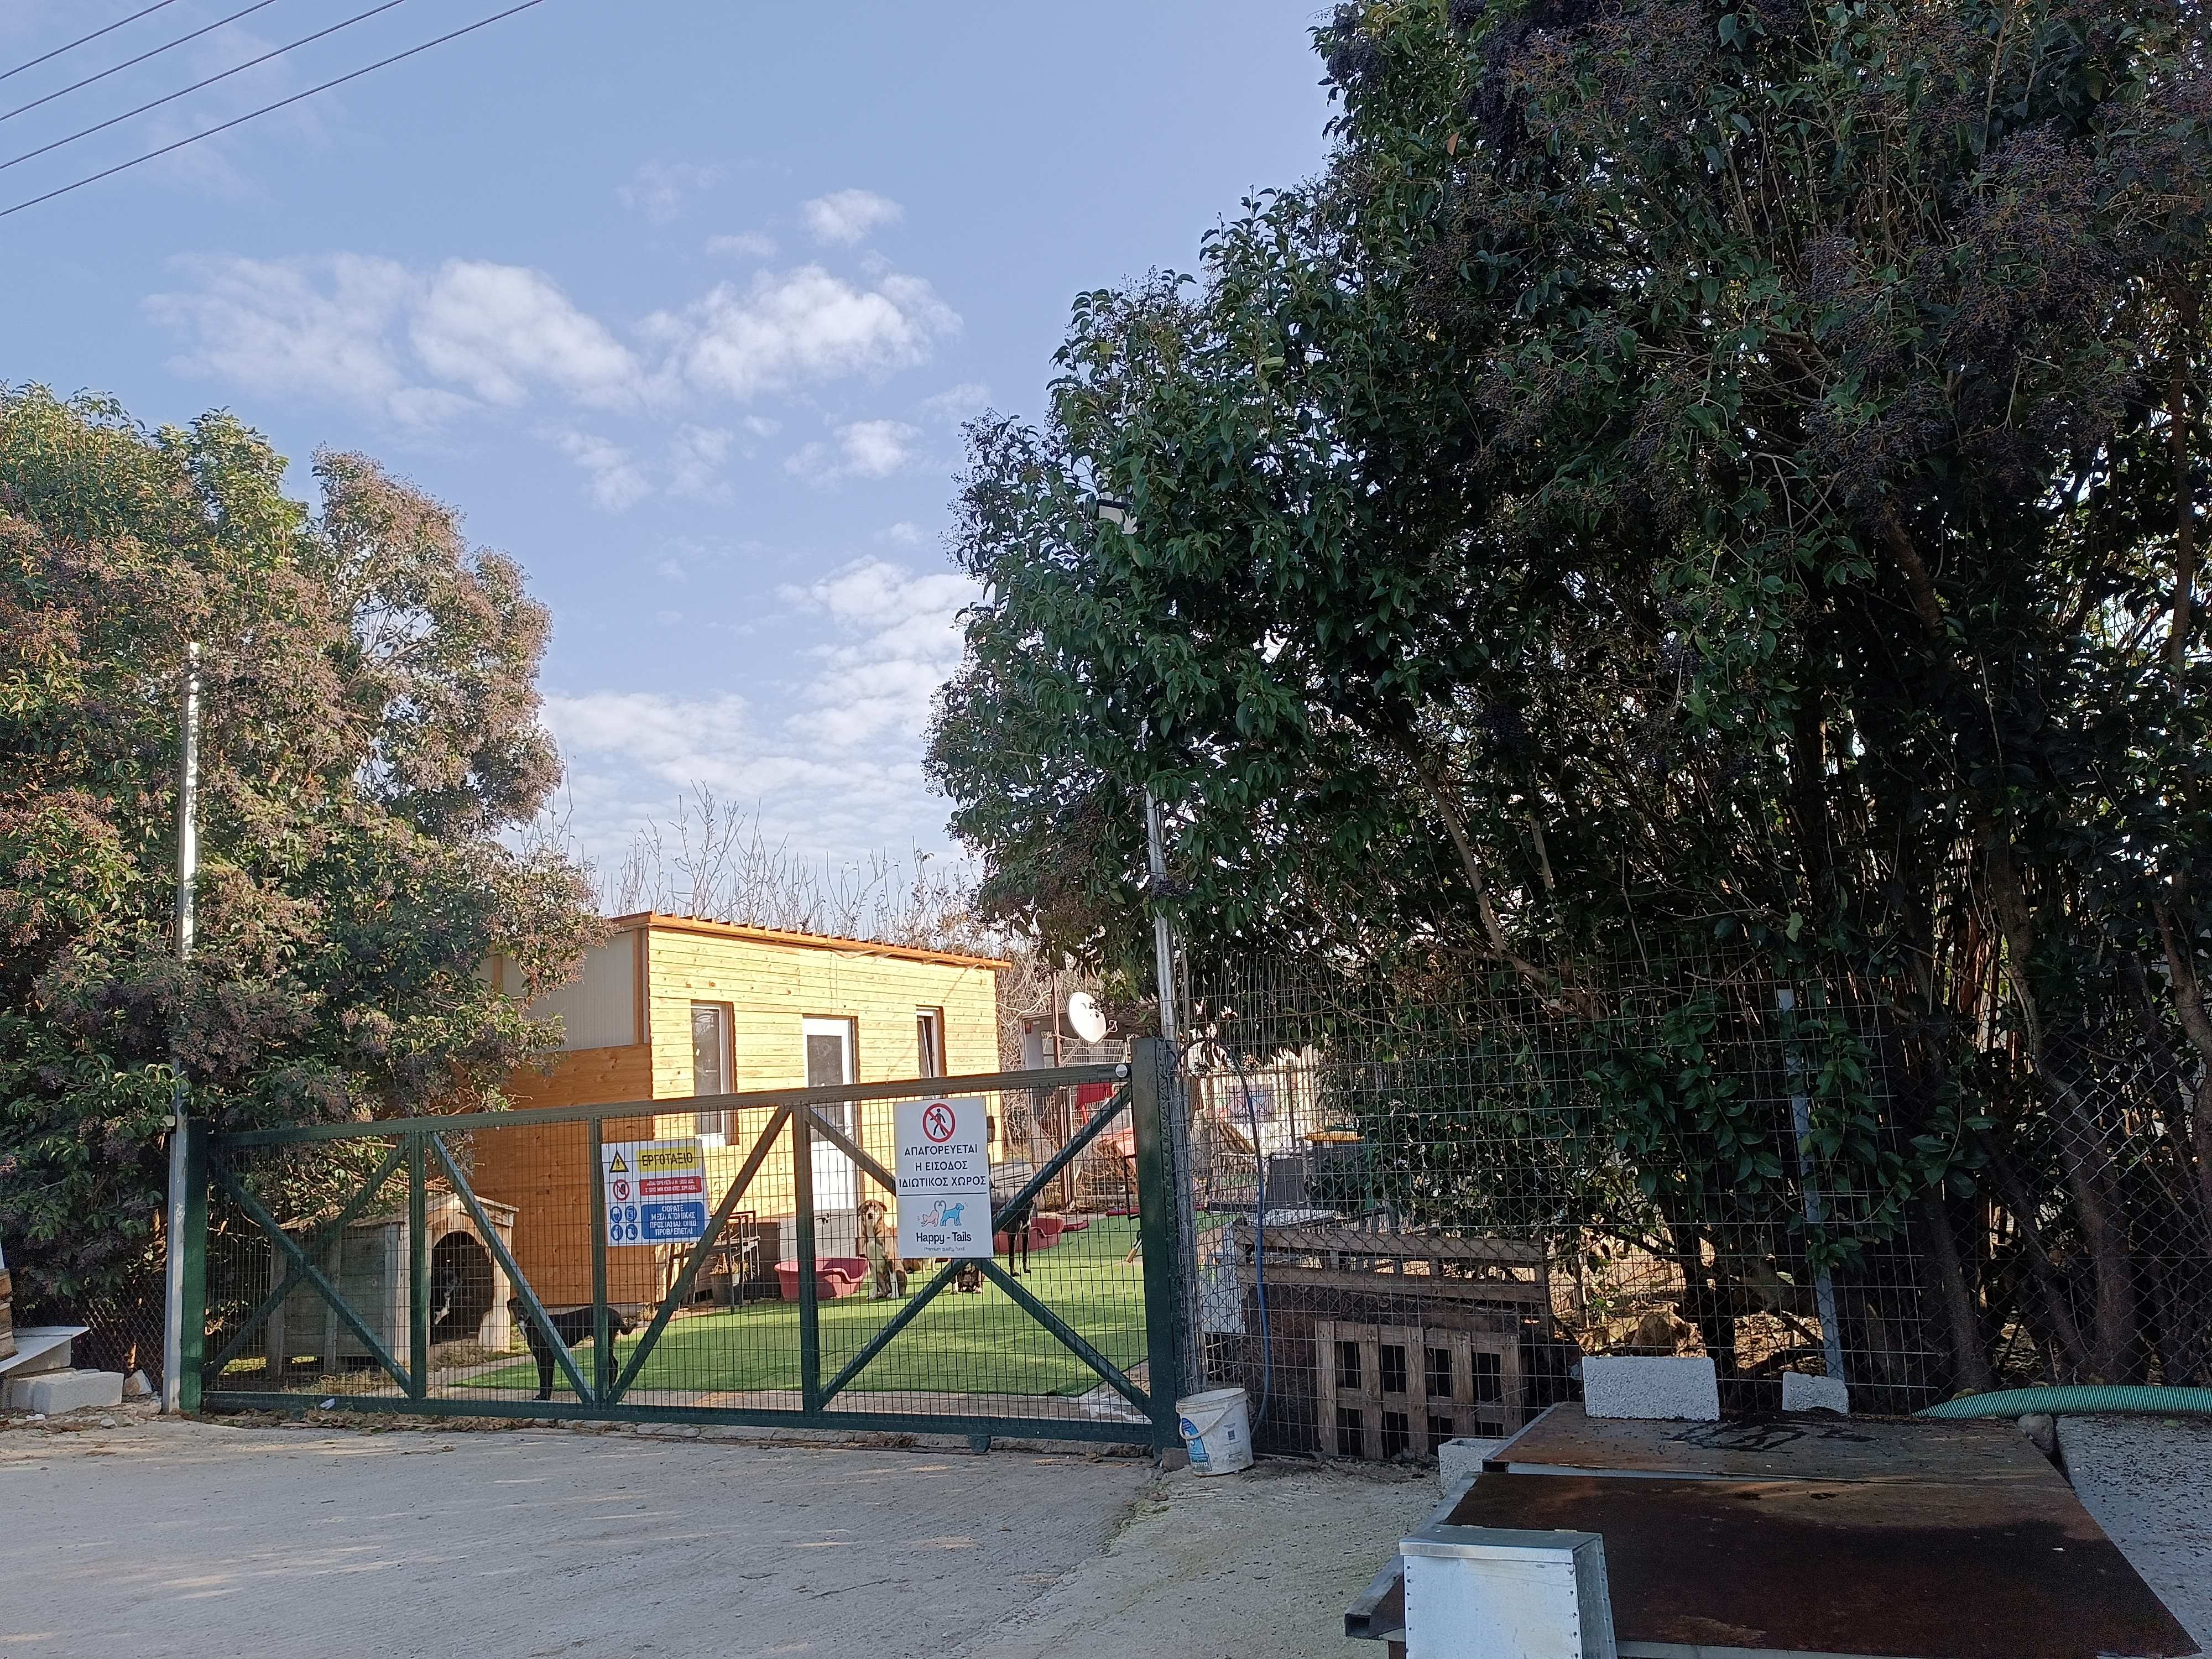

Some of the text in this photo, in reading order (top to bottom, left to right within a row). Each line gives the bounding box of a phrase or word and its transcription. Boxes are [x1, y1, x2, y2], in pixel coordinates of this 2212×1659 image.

[905, 1144, 977, 1156] ΑΠΑΓΟΡΕΥΕΤΑΙ
[642, 1152, 692, 1166] ΕΡΓΟΤΑΞΙΟ
[915, 1161, 968, 1171] Η ΕΙΣΟΔΟΣ
[899, 1176, 986, 1188] ΙΔΙΩΤΙΚΟΣ ΧΩΡΟΣ
[667, 1212, 696, 1220] ΑΤΟΜΙΚΗΣ
[916, 1233, 945, 1244] Happy
[952, 1232, 972, 1242] Tails
